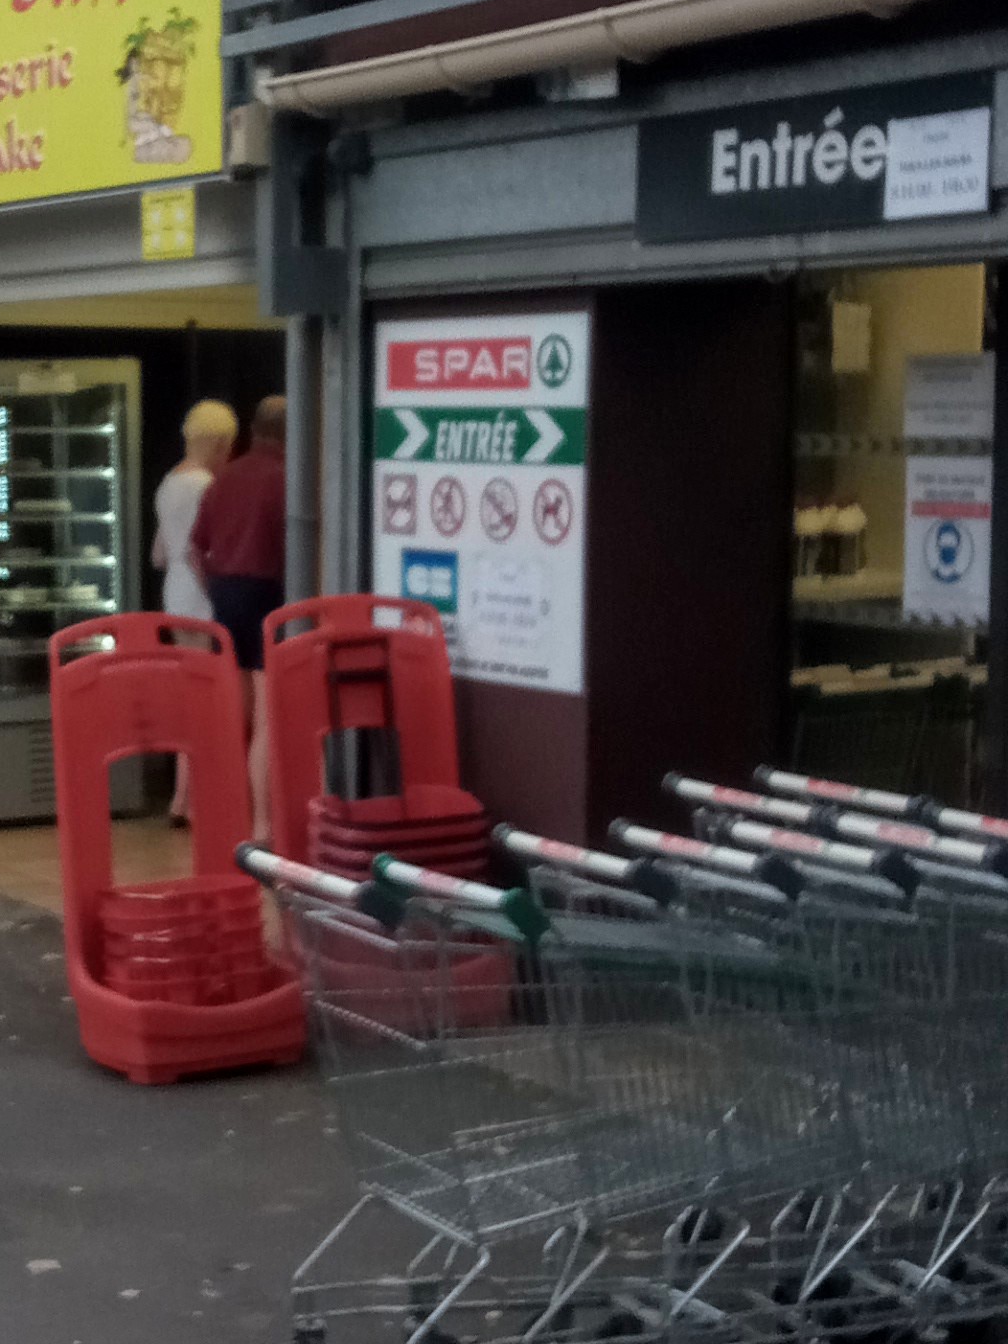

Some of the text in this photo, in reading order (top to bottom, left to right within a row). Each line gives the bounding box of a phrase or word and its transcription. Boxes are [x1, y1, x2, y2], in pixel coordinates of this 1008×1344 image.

[710, 106, 887, 194] Entrée
[414, 345, 528, 383] SPAR
[434, 411, 519, 462] ENTRÉE
